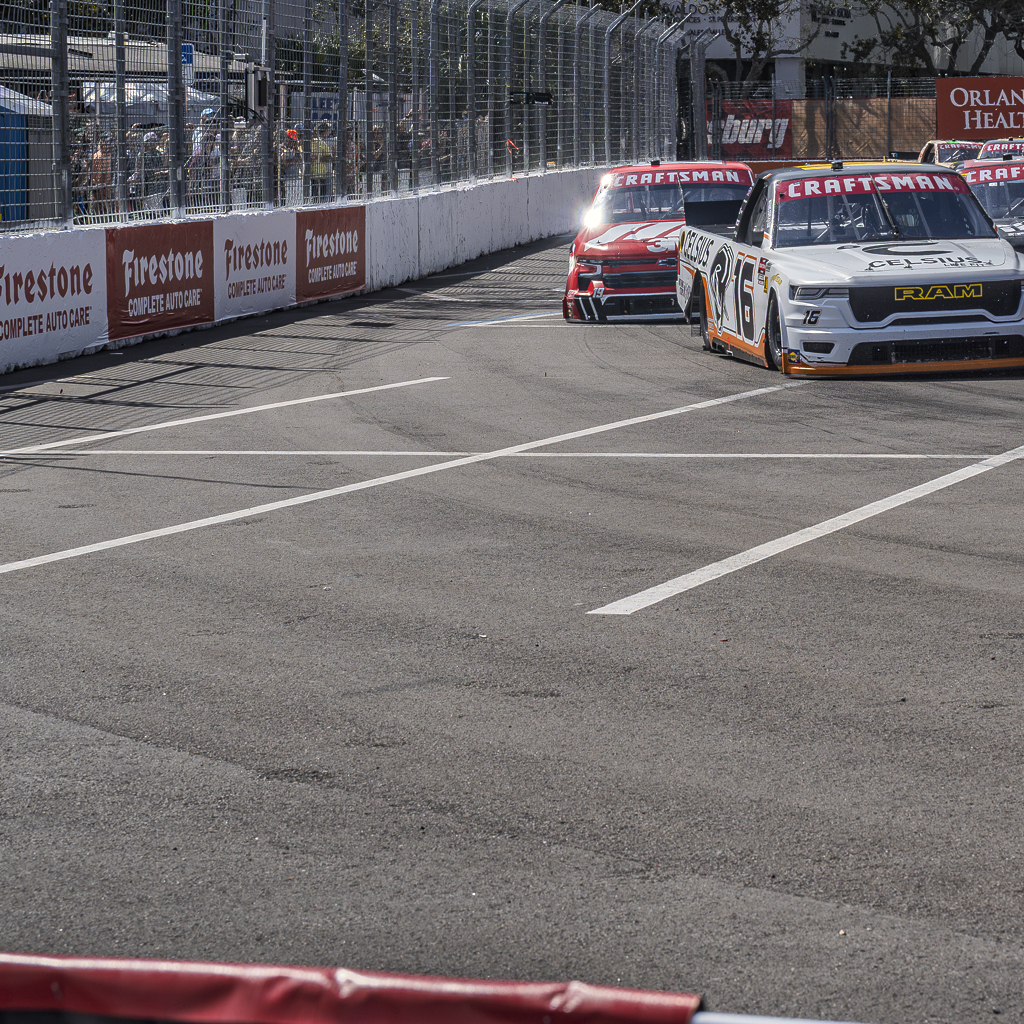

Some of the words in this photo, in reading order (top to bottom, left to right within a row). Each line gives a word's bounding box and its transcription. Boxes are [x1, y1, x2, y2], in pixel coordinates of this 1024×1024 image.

[614, 171, 740, 187] CRAFTSMAN
[788, 175, 954, 198] CRAFTSMAN
[305, 228, 359, 268] Firestone
[224, 238, 288, 282] Firestone
[868, 256, 983, 268] CELSIUS
[122, 248, 203, 297] Firestone
[309, 265, 332, 283] COMPLETE
[333, 263, 345, 280] AUTO
[228, 278, 256, 299] COMPLETE
[257, 276, 271, 294] AUTO
[593, 287, 604, 298] 19
[732, 253, 756, 345] 16
[894, 283, 982, 301] RAM
[128, 294, 164, 317] COMPLETE
[165, 291, 183, 311] AUTO
[46, 309, 68, 333] AUTO
[803, 308, 821, 325] 16
